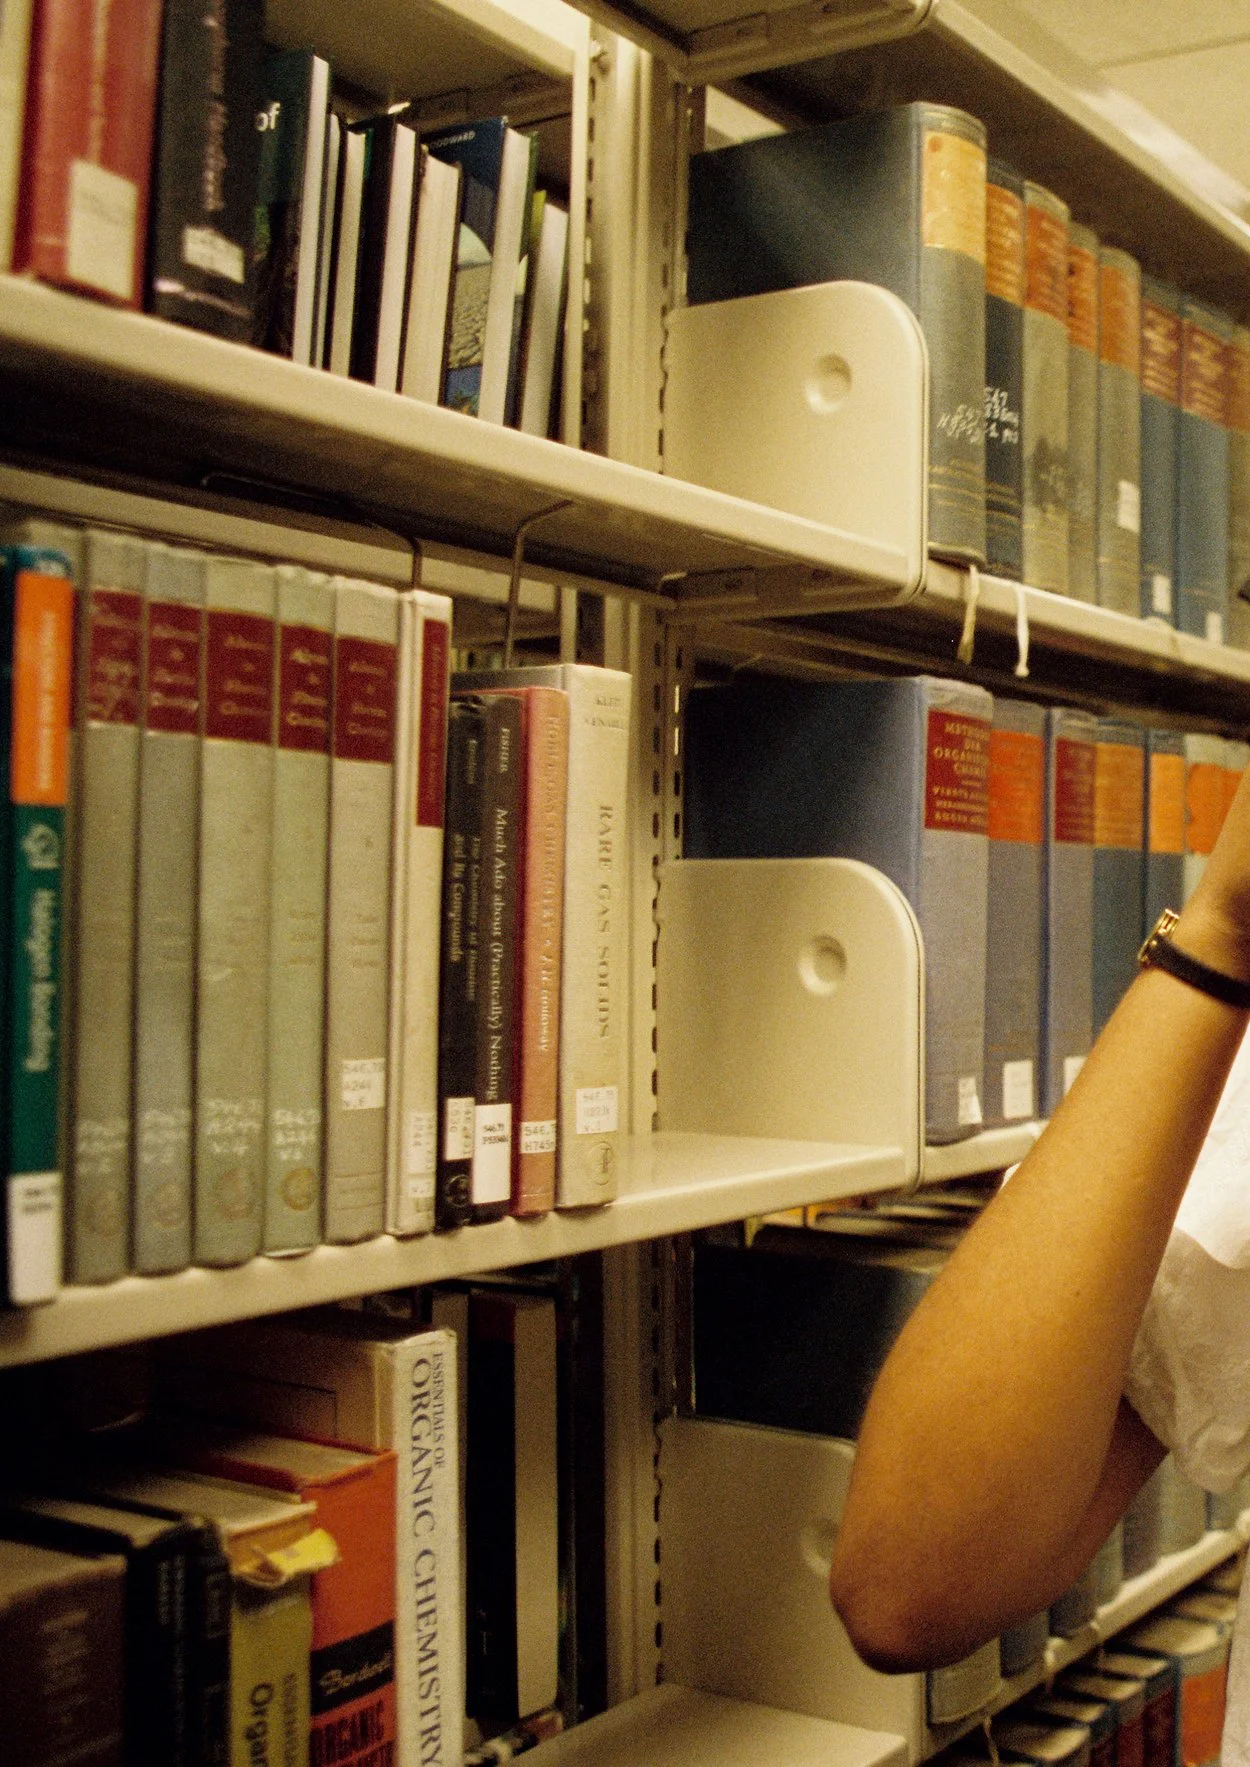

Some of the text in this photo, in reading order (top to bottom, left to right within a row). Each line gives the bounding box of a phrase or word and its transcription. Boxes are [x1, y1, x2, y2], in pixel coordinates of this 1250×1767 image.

[255, 102, 281, 132] of
[494, 808, 508, 853] Much
[494, 857, 507, 890] Ado
[492, 894, 505, 936] about
[597, 806, 613, 1038] RARE GAS SOLIDS
[488, 942, 504, 1029] (Practically)
[432, 1352, 445, 1469] ESSENTIALS OF
[411, 1357, 442, 1766] ORGANIC CHEMISTRY
